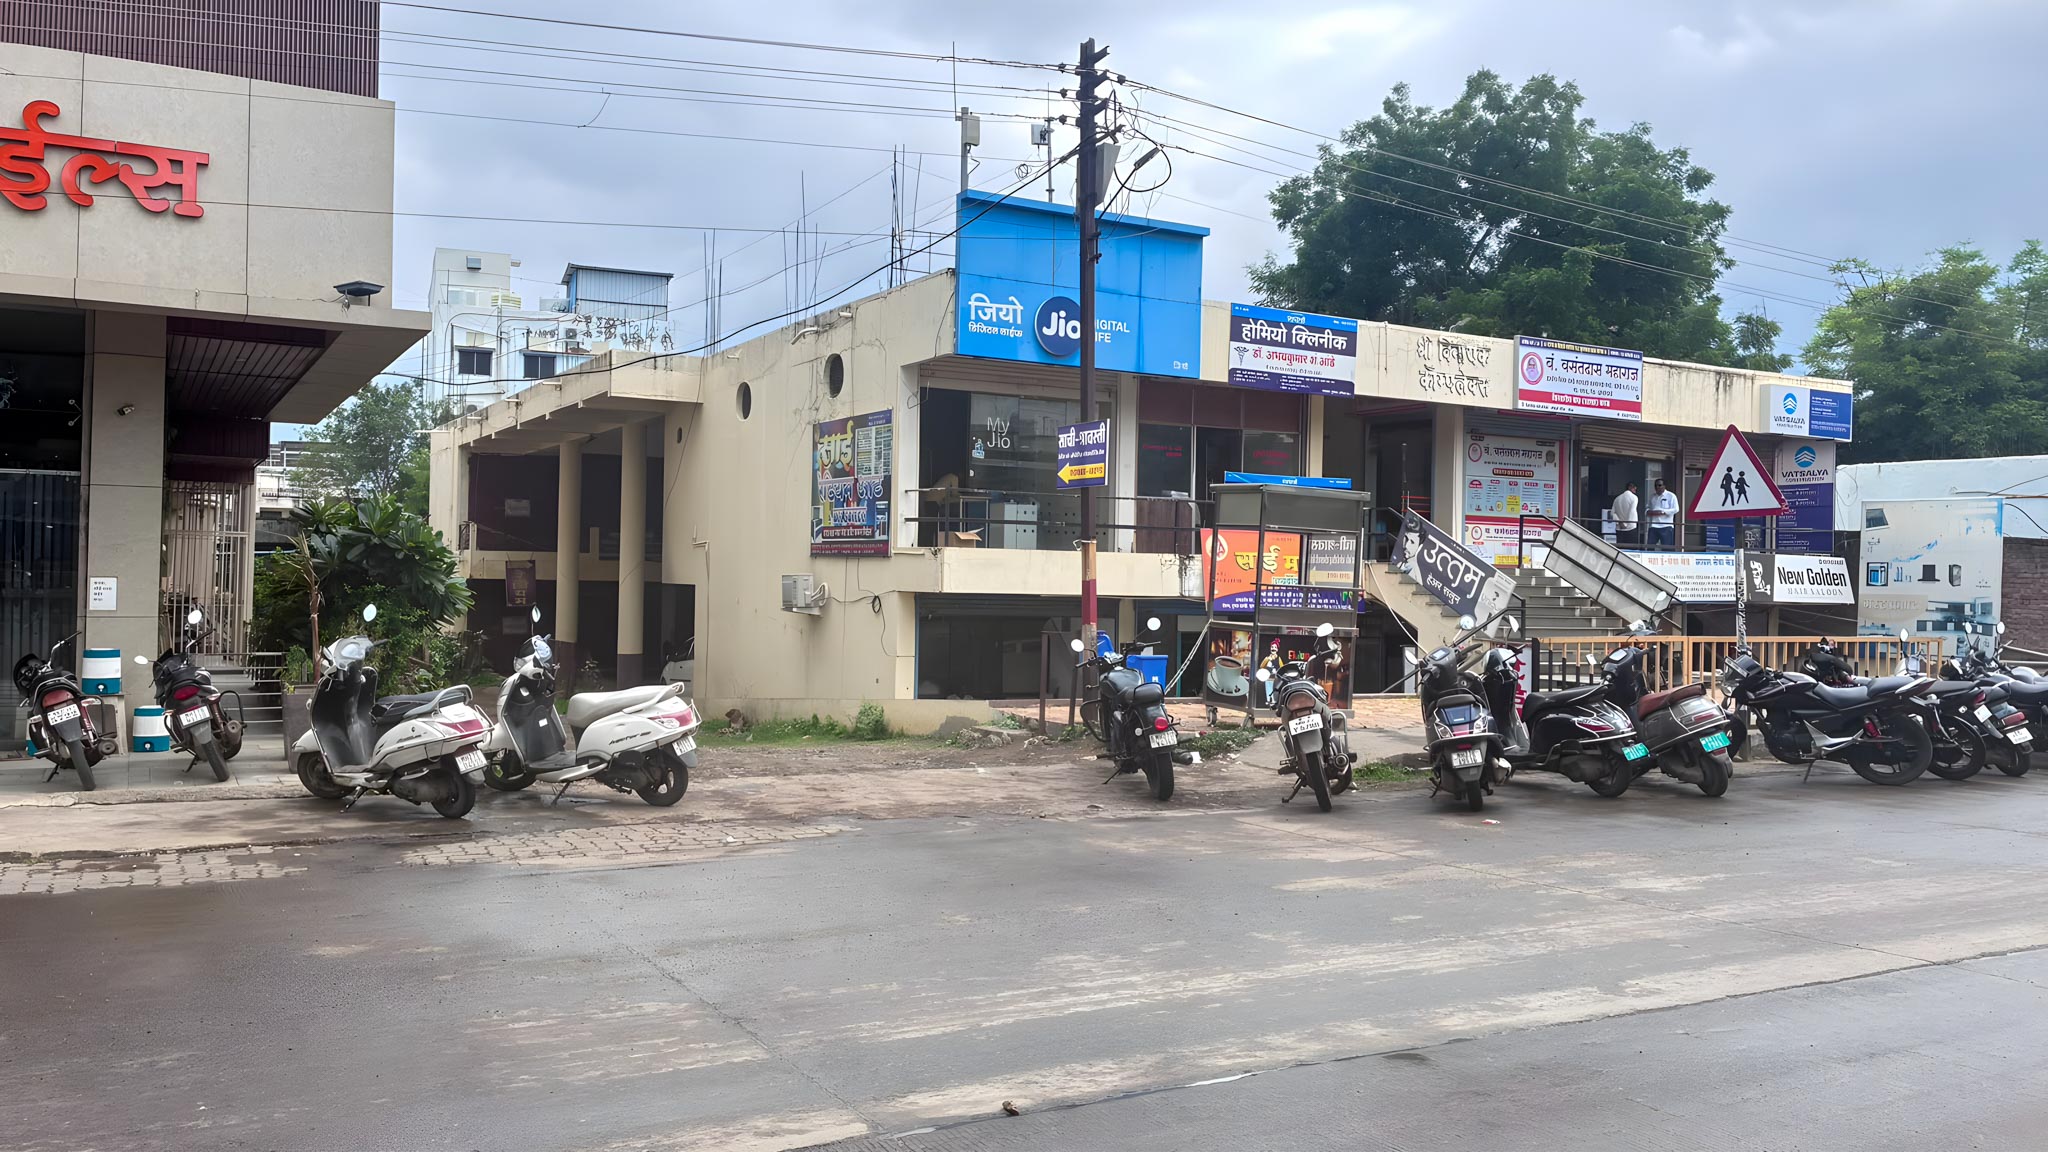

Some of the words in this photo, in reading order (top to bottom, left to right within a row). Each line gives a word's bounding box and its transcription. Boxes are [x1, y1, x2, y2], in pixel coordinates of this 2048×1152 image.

[968, 292, 1024, 325] जियो
[1042, 310, 1081, 339] Jio
[1096, 319, 1130, 333] IGITAL
[1241, 318, 1288, 343] होमियो
[1291, 324, 1348, 350] क्लिनीक
[1095, 331, 1111, 343] IFE
[987, 416, 1010, 437] My
[987, 431, 1011, 449] Jio
[1781, 469, 1829, 478] VATSALYA
[1777, 566, 1805, 585] New
[1806, 567, 1848, 587] Golden
